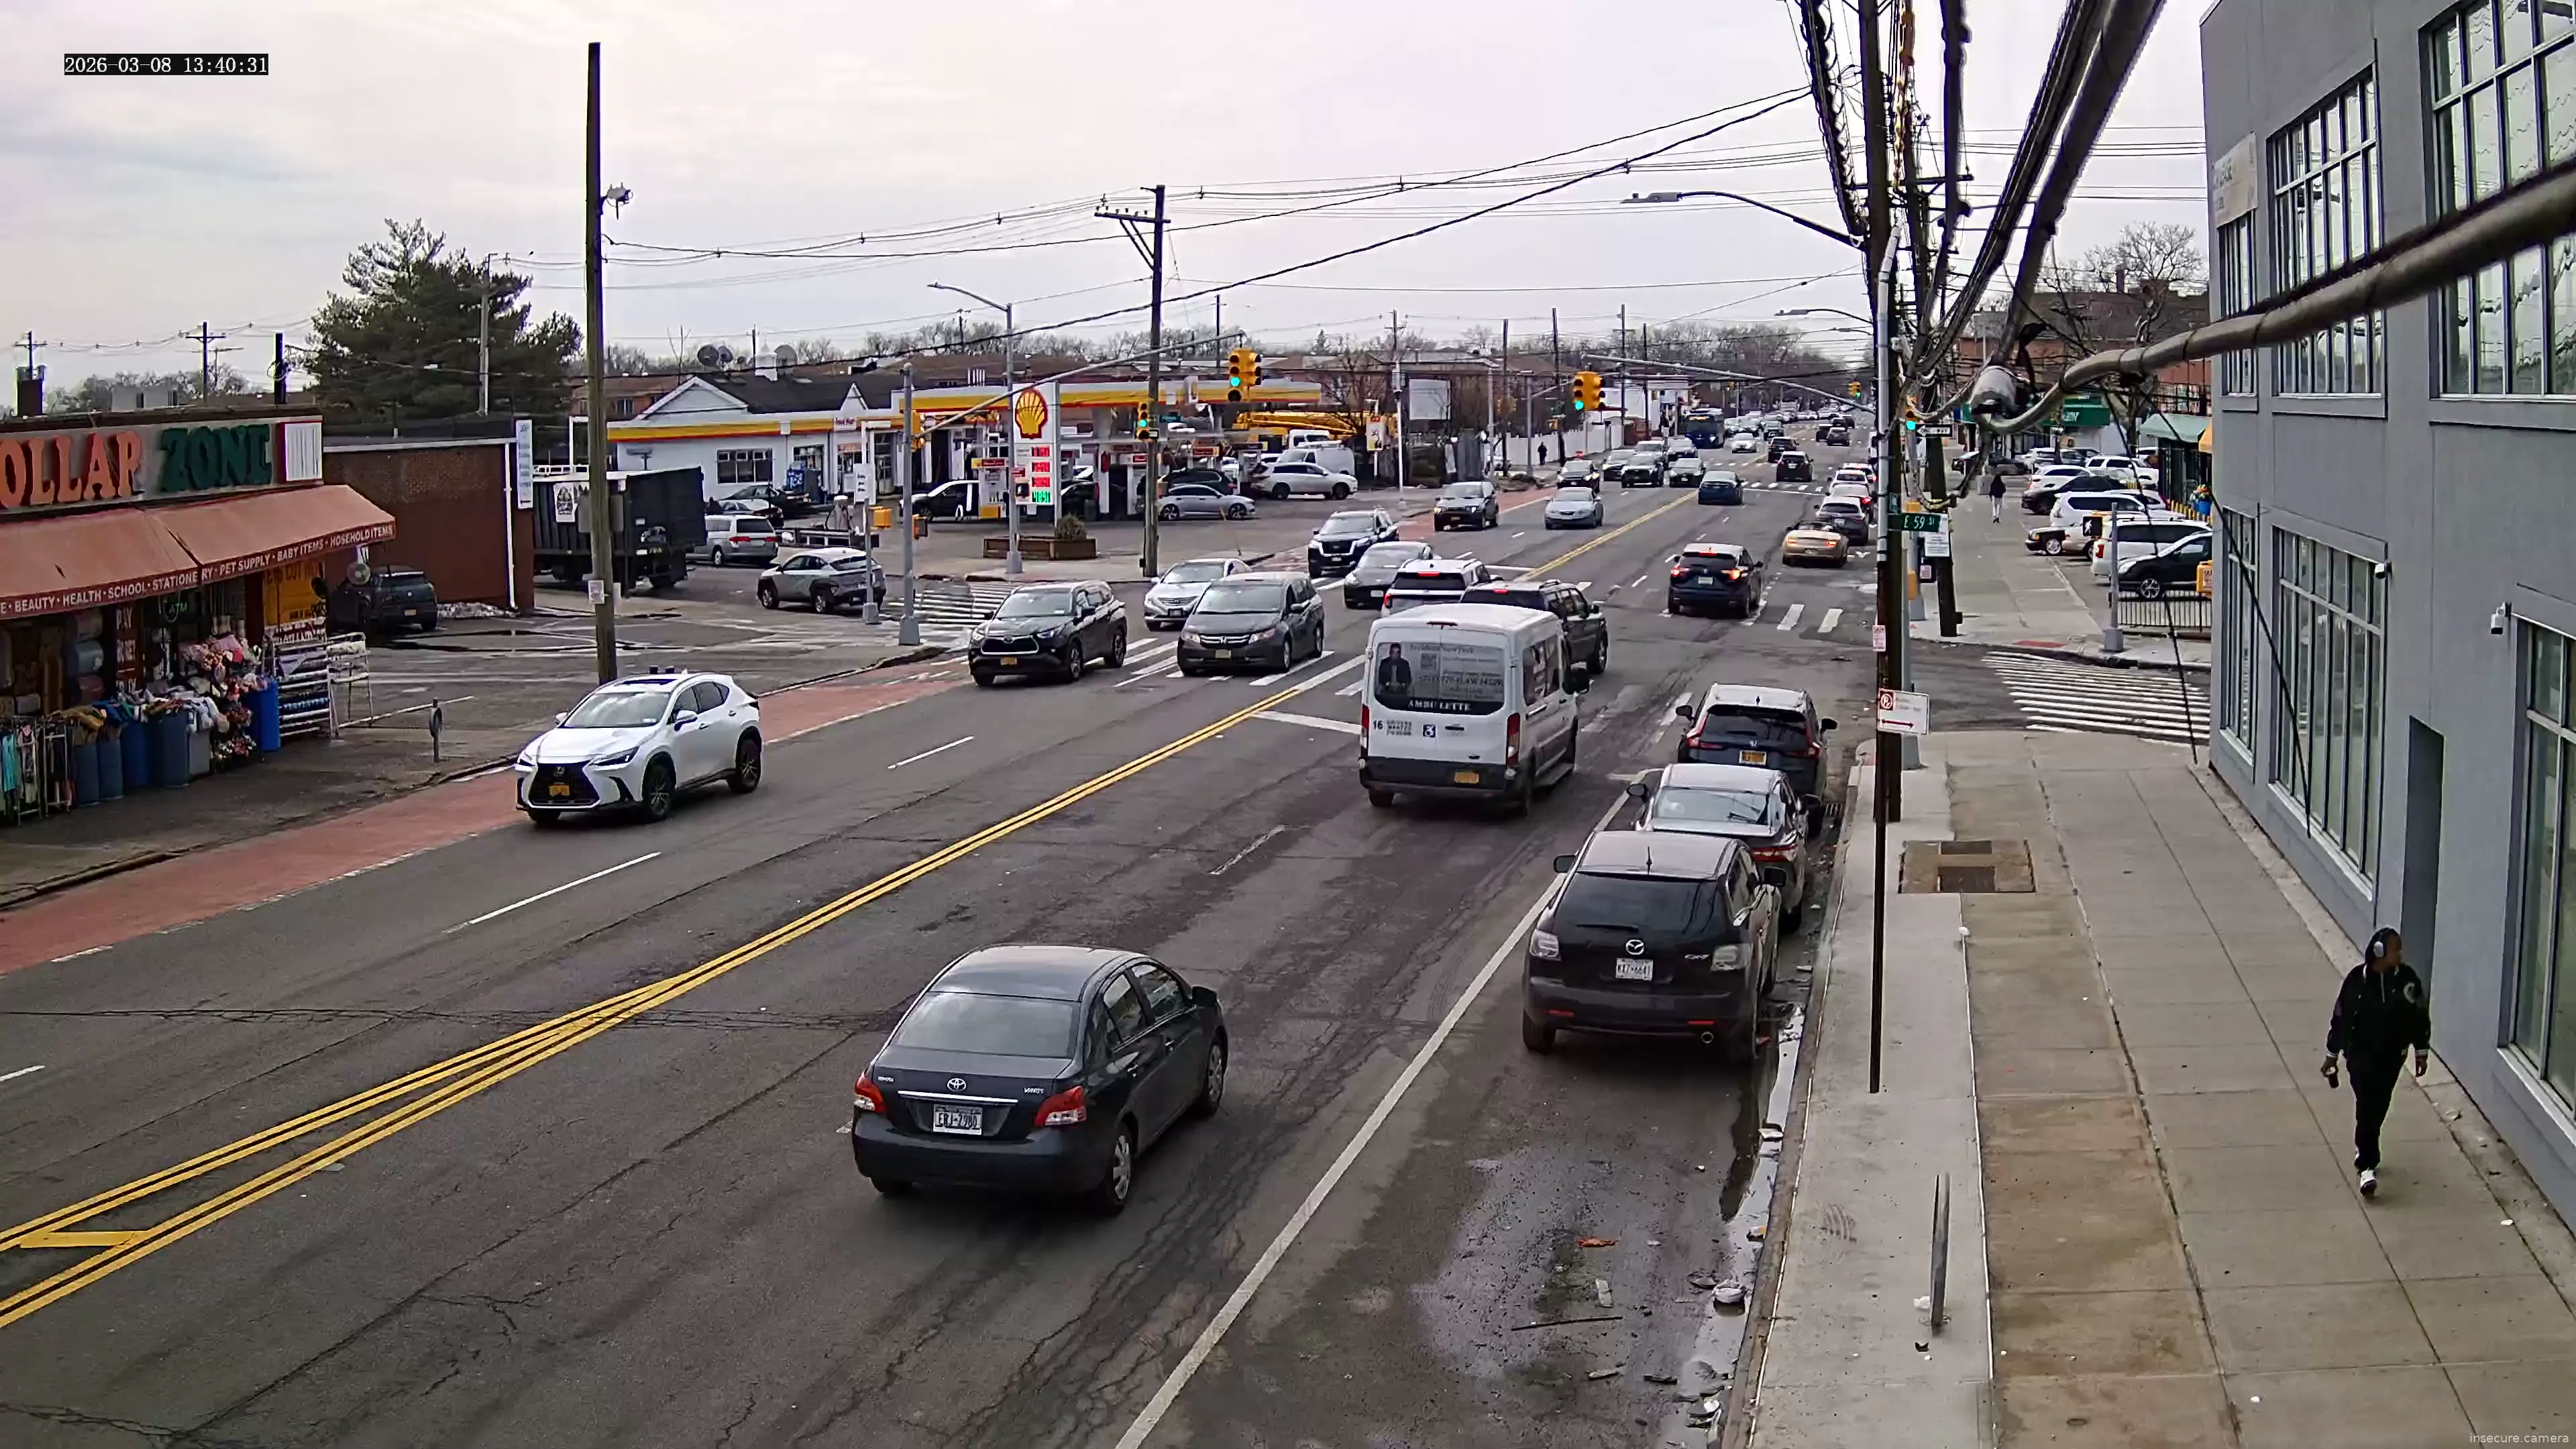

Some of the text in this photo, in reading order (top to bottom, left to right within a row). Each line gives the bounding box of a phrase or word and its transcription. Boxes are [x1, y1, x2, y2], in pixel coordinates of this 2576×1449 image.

[160, 424, 272, 492] ZONE
[1904, 515, 1910, 529] E
[1914, 515, 1925, 529] 59
[15, 596, 56, 612] BEAUTY
[63, 589, 101, 607] HEALTH
[108, 582, 147, 599] SCHOOL
[219, 562, 236, 576] PET
[238, 553, 271, 571] SUPPLY
[277, 546, 299, 561] BABY
[300, 539, 324, 555] ITEMS
[1373, 720, 1383, 730] 16
